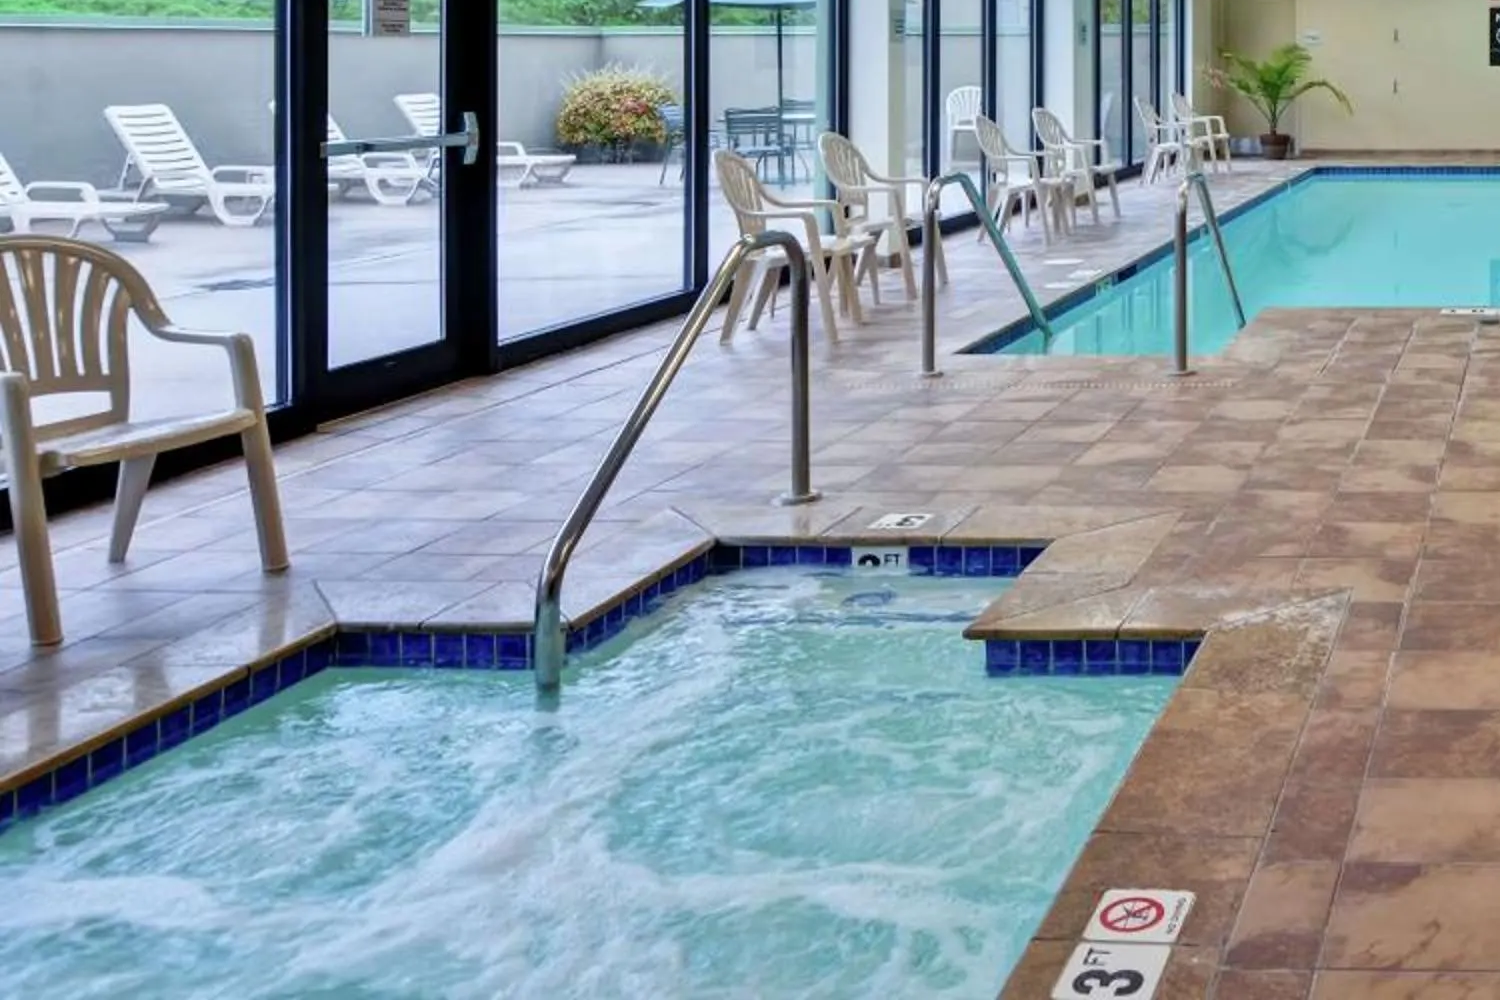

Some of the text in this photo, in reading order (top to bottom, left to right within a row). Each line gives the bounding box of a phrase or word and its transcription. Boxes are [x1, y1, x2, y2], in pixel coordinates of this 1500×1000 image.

[884, 553, 901, 567] FT
[1072, 947, 1144, 996] 3 FT
